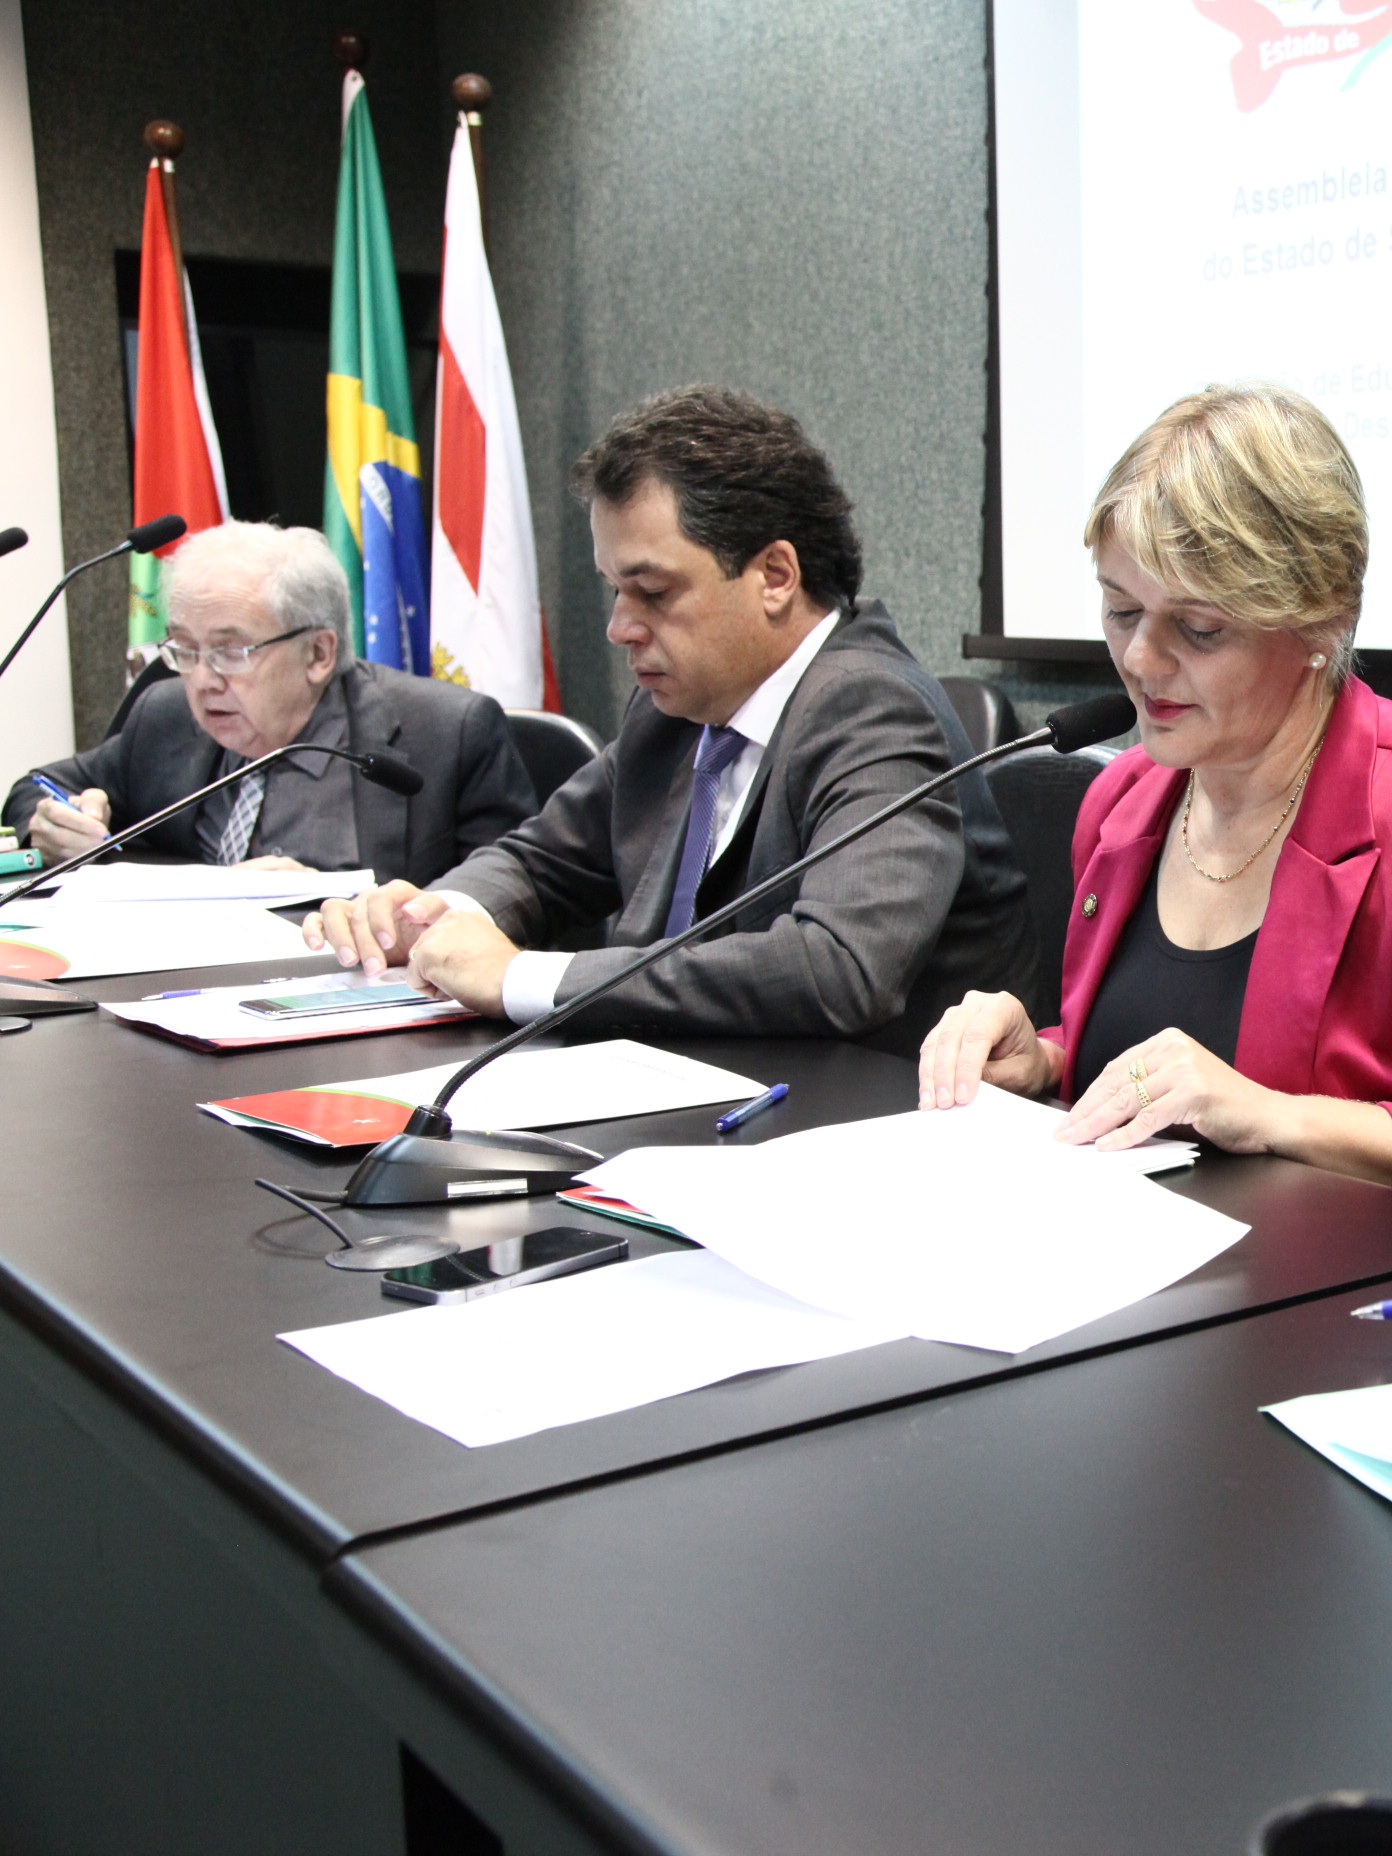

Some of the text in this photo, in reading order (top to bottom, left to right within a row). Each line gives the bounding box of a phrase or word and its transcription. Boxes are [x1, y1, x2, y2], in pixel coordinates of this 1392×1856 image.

[1260, 29, 1360, 70] Estado de
[1232, 162, 1387, 218] Assembleia
[1202, 250, 1232, 282] do
[1243, 234, 1334, 276] Estado
[1345, 227, 1377, 262] de
[1313, 368, 1341, 397] de
